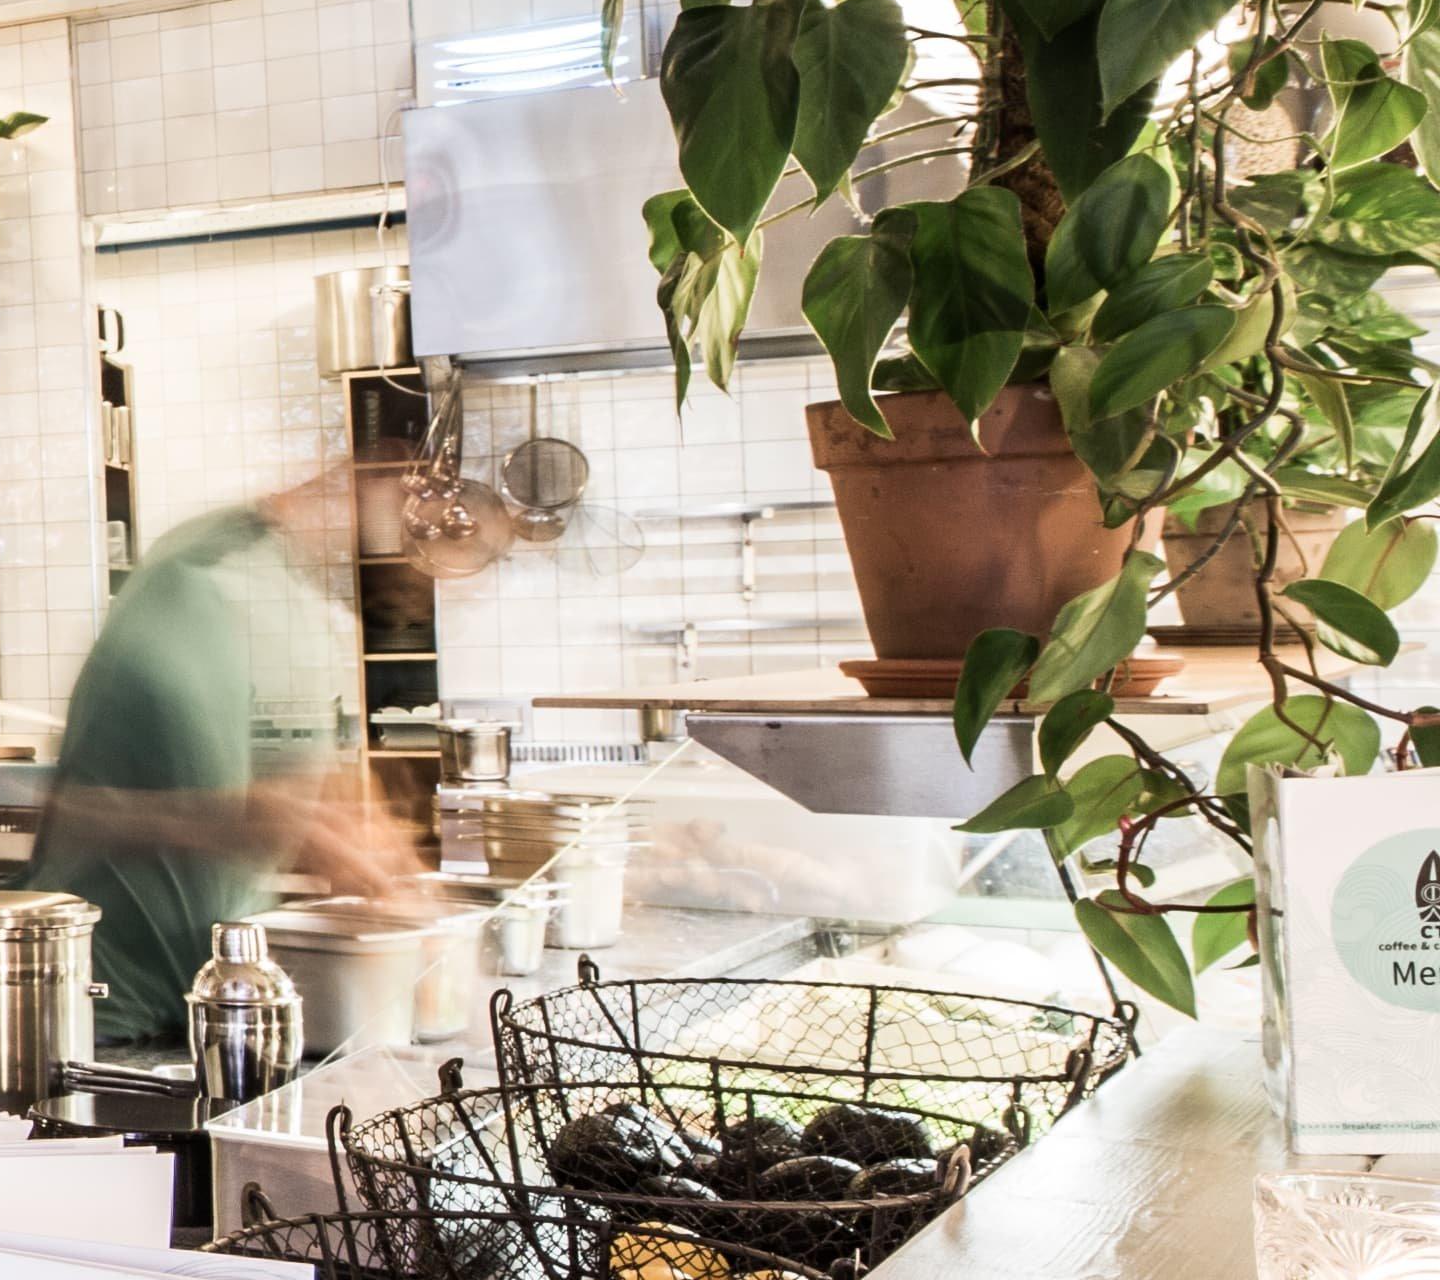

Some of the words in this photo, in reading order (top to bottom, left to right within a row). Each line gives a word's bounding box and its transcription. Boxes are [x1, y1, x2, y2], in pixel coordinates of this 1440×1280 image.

[1378, 941, 1417, 951] coffee
[1420, 941, 1430, 951] &
[1393, 961, 1440, 986] Me
